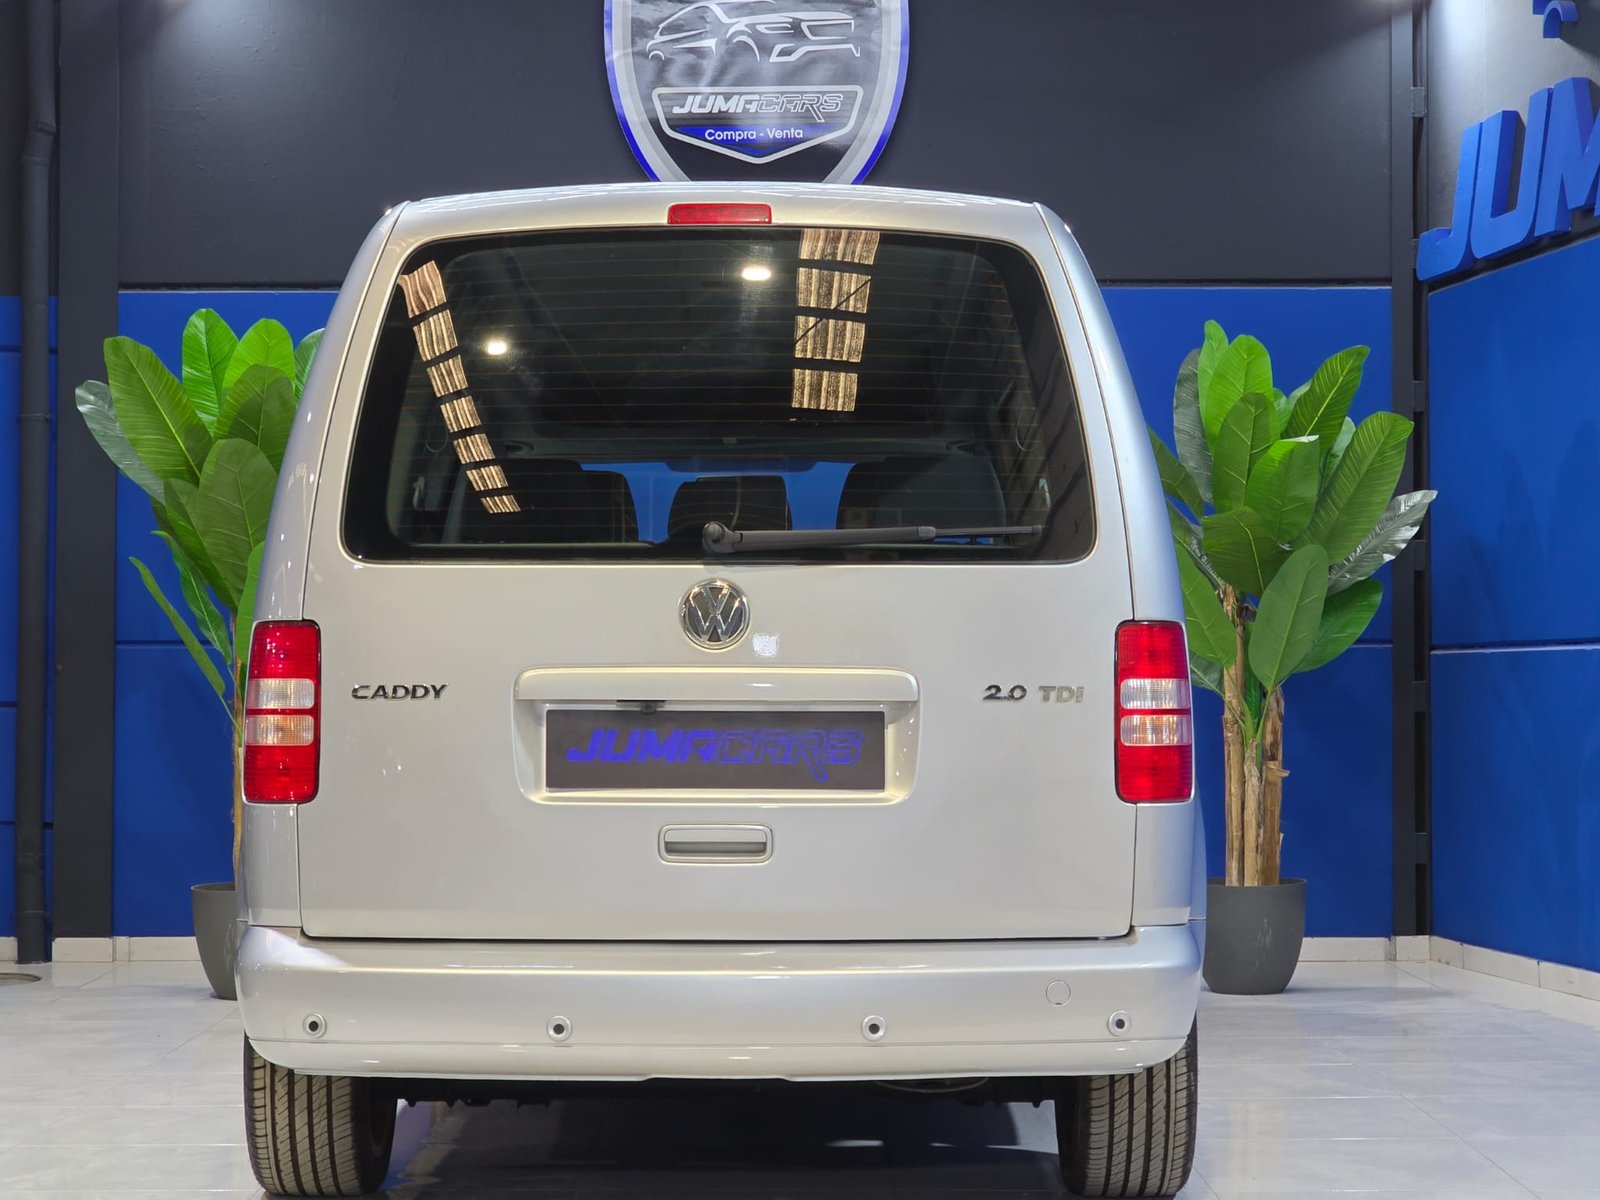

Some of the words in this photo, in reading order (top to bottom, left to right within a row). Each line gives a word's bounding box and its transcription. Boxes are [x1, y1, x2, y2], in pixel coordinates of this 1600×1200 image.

[672, 94, 843, 122] JUMACARS
[704, 129, 757, 142] Compra
[766, 128, 804, 139] Venta
[351, 683, 449, 700] CADDY
[982, 684, 1027, 702] 2.0
[1038, 685, 1085, 703] TDI
[566, 729, 864, 782] JUMACARS
